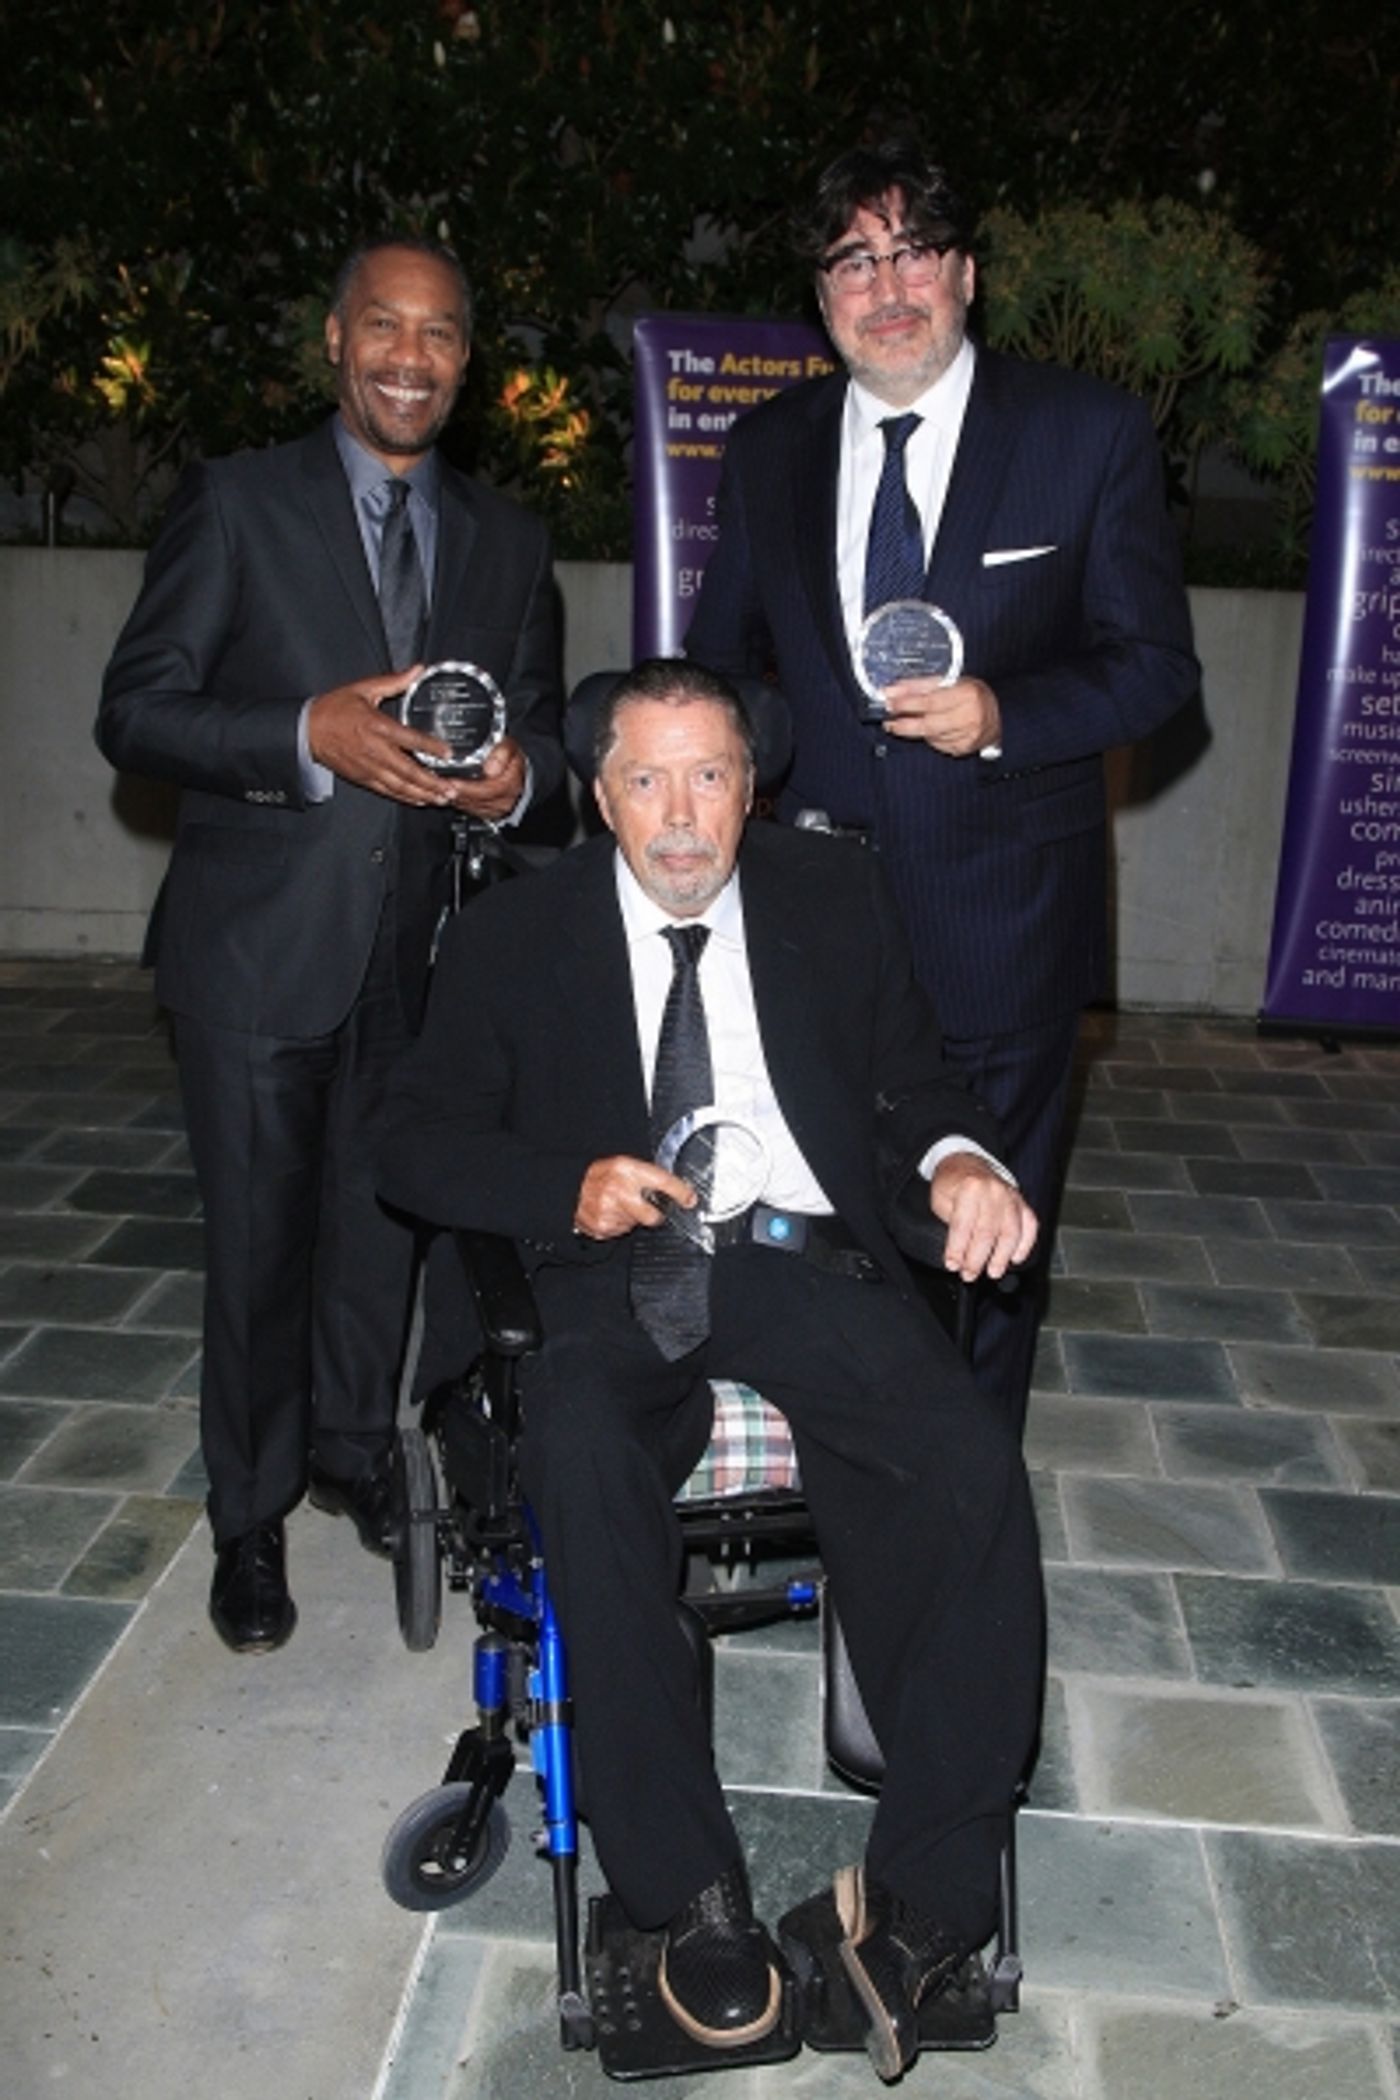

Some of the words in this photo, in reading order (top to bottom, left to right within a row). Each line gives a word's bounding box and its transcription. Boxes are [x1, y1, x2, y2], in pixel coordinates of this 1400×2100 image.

[668, 350, 715, 374] The
[720, 352, 801, 377] Actors
[667, 378, 705, 402] for
[668, 406, 692, 430] in
[1355, 399, 1395, 424] for
[1354, 429, 1378, 453] in
[1326, 665, 1377, 684] make
[1339, 794, 1400, 817] usher
[1316, 920, 1400, 943] comed
[1319, 942, 1400, 965] cinemat
[1301, 965, 1346, 989] and
